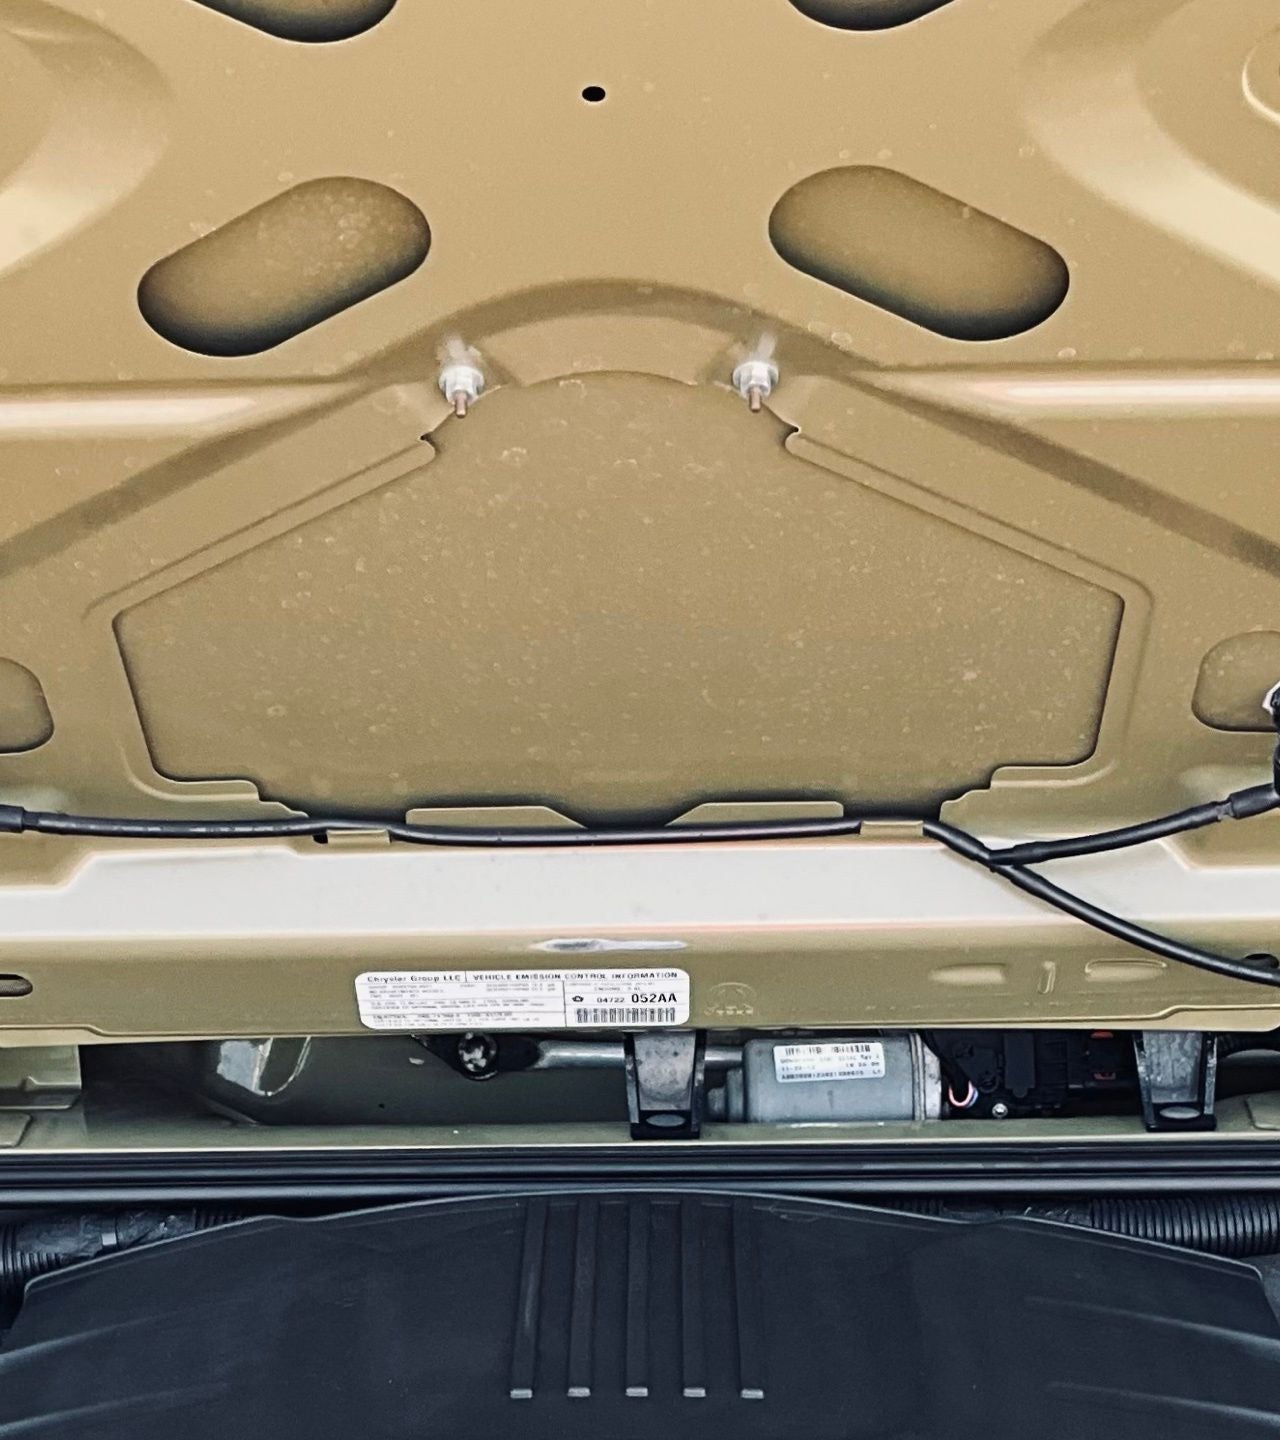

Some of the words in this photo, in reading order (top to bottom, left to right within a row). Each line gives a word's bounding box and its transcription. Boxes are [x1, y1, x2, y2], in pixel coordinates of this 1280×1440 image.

[368, 975, 407, 985] Chrysler
[410, 975, 440, 985] Group
[443, 974, 461, 982] LLC
[630, 993, 678, 1004] 052AA
